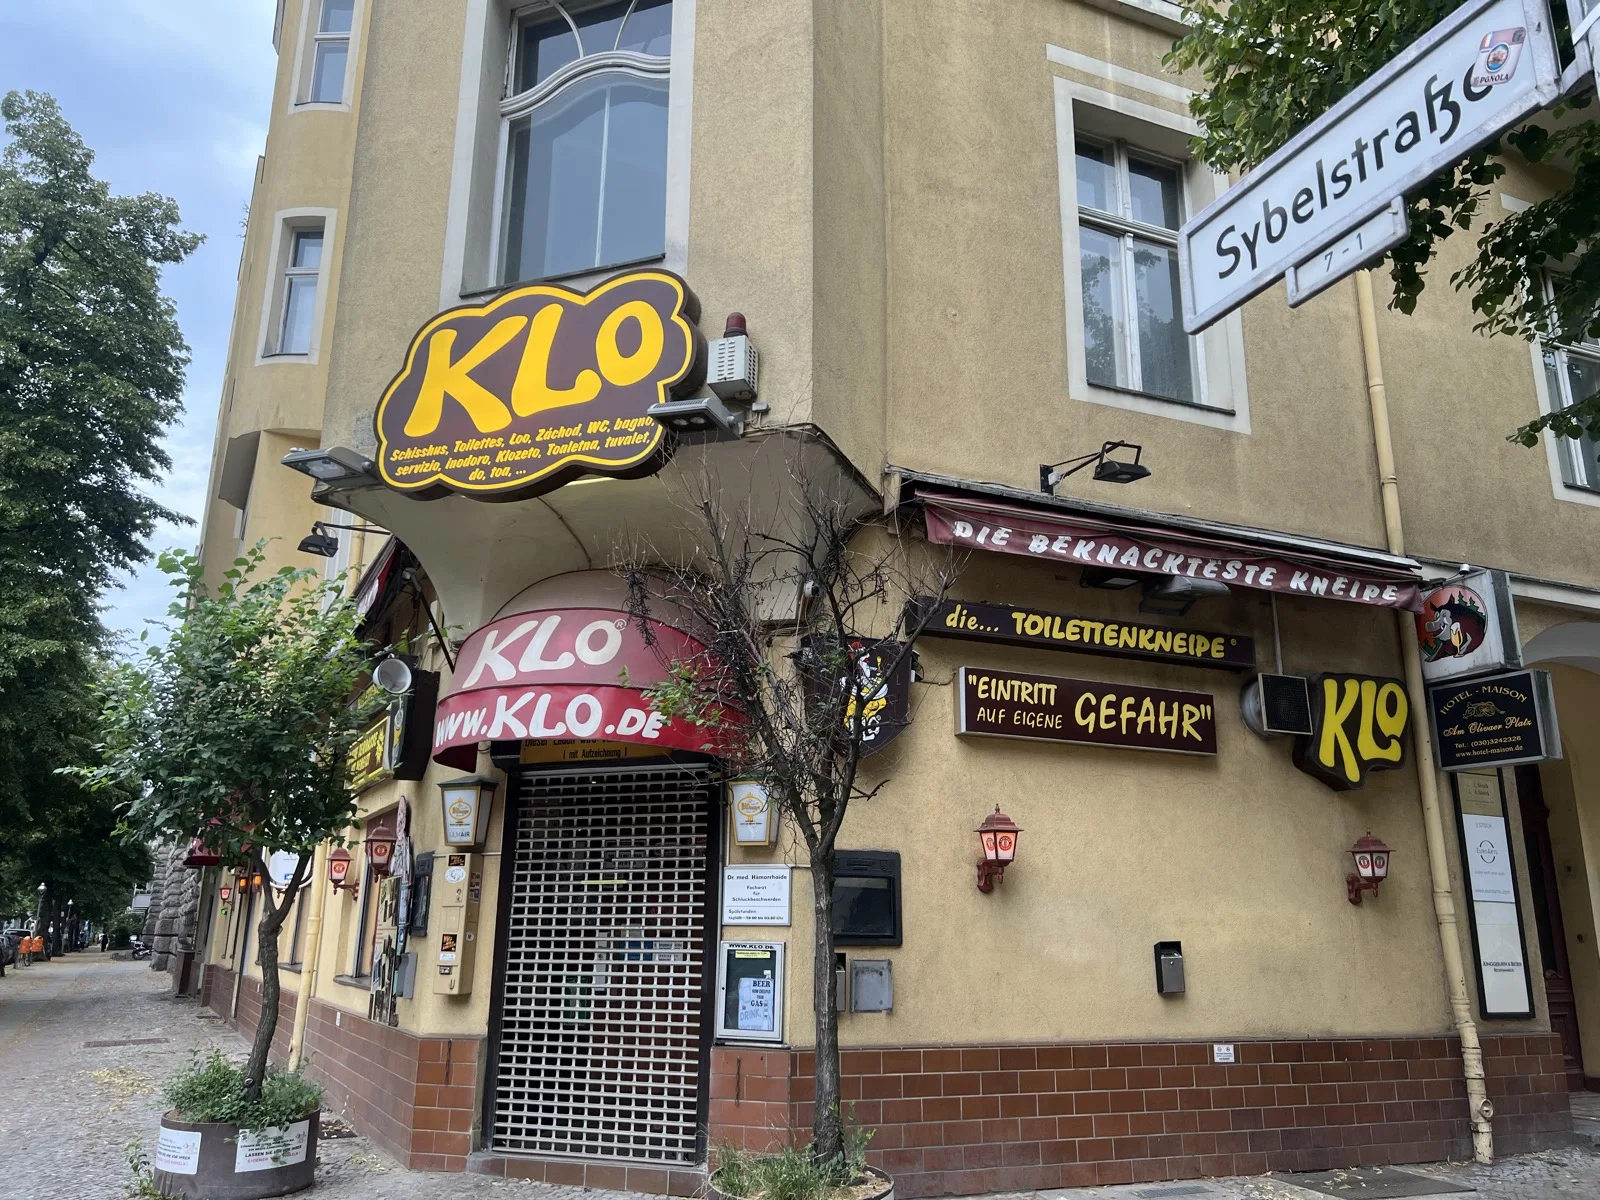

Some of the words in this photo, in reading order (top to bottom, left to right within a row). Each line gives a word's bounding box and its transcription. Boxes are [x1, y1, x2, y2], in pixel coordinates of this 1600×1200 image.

[404, 301, 664, 437] KLO
[390, 444, 449, 462] Schisshus,
[453, 435, 506, 453] Toilettes,
[509, 432, 532, 446] Loo,
[536, 423, 582, 441] Záchod,
[587, 419, 611, 434] WC,
[395, 460, 441, 477] servizio,
[445, 455, 492, 472] inodoro,
[496, 447, 542, 464] Klozeto,
[547, 440, 601, 456] Toaletna,
[604, 431, 650, 447] tuvalet,
[468, 469, 486, 481] do,
[490, 466, 512, 478] toa,
[953, 520, 1013, 546] DIE
[1027, 533, 1277, 586] BEKNACKTESTE
[1289, 570, 1398, 601] KNEIPE
[945, 608, 999, 632] die...
[968, 674, 1058, 706] "EINTRITT
[1440, 690, 1473, 715] HOTEL
[1482, 685, 1528, 703] MAISON
[976, 706, 1006, 725] AUF
[1013, 710, 1064, 729] EIGENE
[1074, 691, 1212, 742] GEFAHR"
[1318, 678, 1409, 784] KLO
[1443, 724, 1465, 736] Am
[1468, 721, 1503, 734] Olivaer
[1504, 716, 1533, 729] Platz
[569, 750, 578, 759] mit
[581, 748, 621, 759] Aufzeichnung
